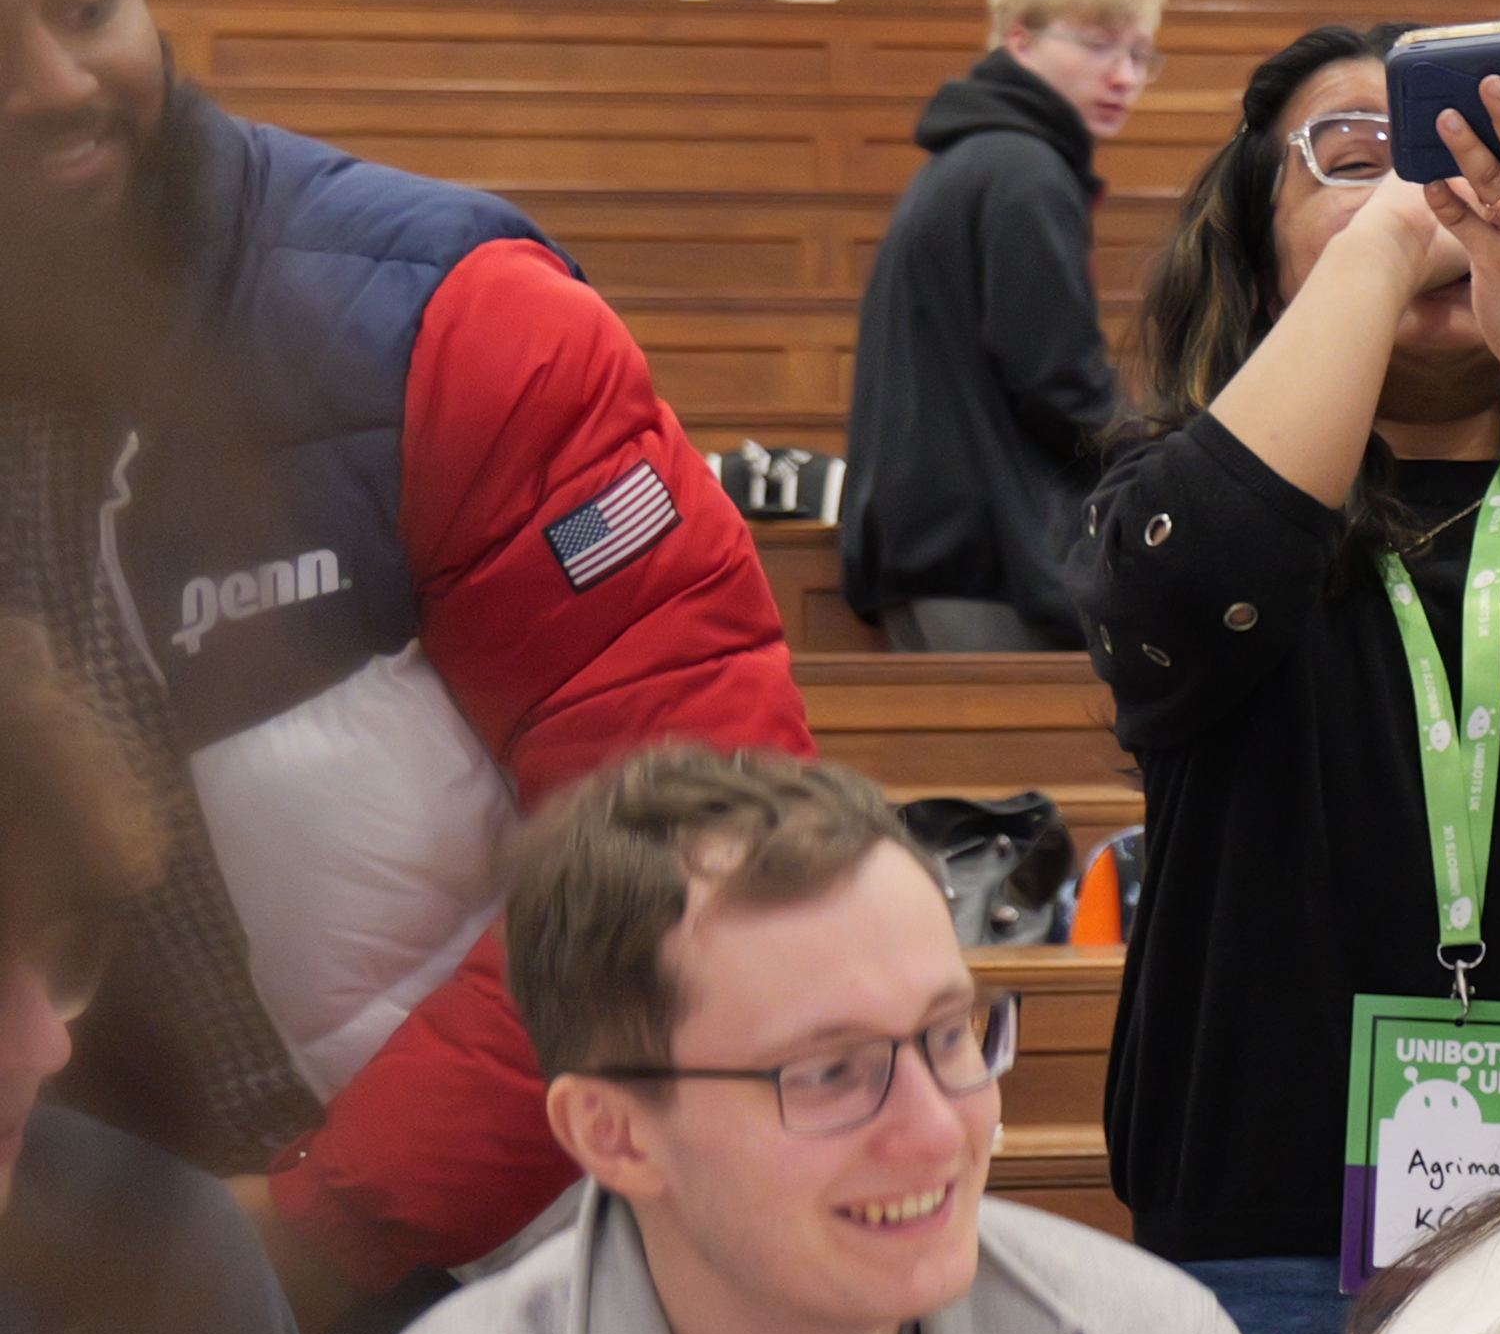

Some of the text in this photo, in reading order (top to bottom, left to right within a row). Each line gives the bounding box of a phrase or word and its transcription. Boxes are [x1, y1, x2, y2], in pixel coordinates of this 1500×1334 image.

[171, 547, 341, 656] penn
[1442, 825, 1462, 895] UNIBOTS UK
